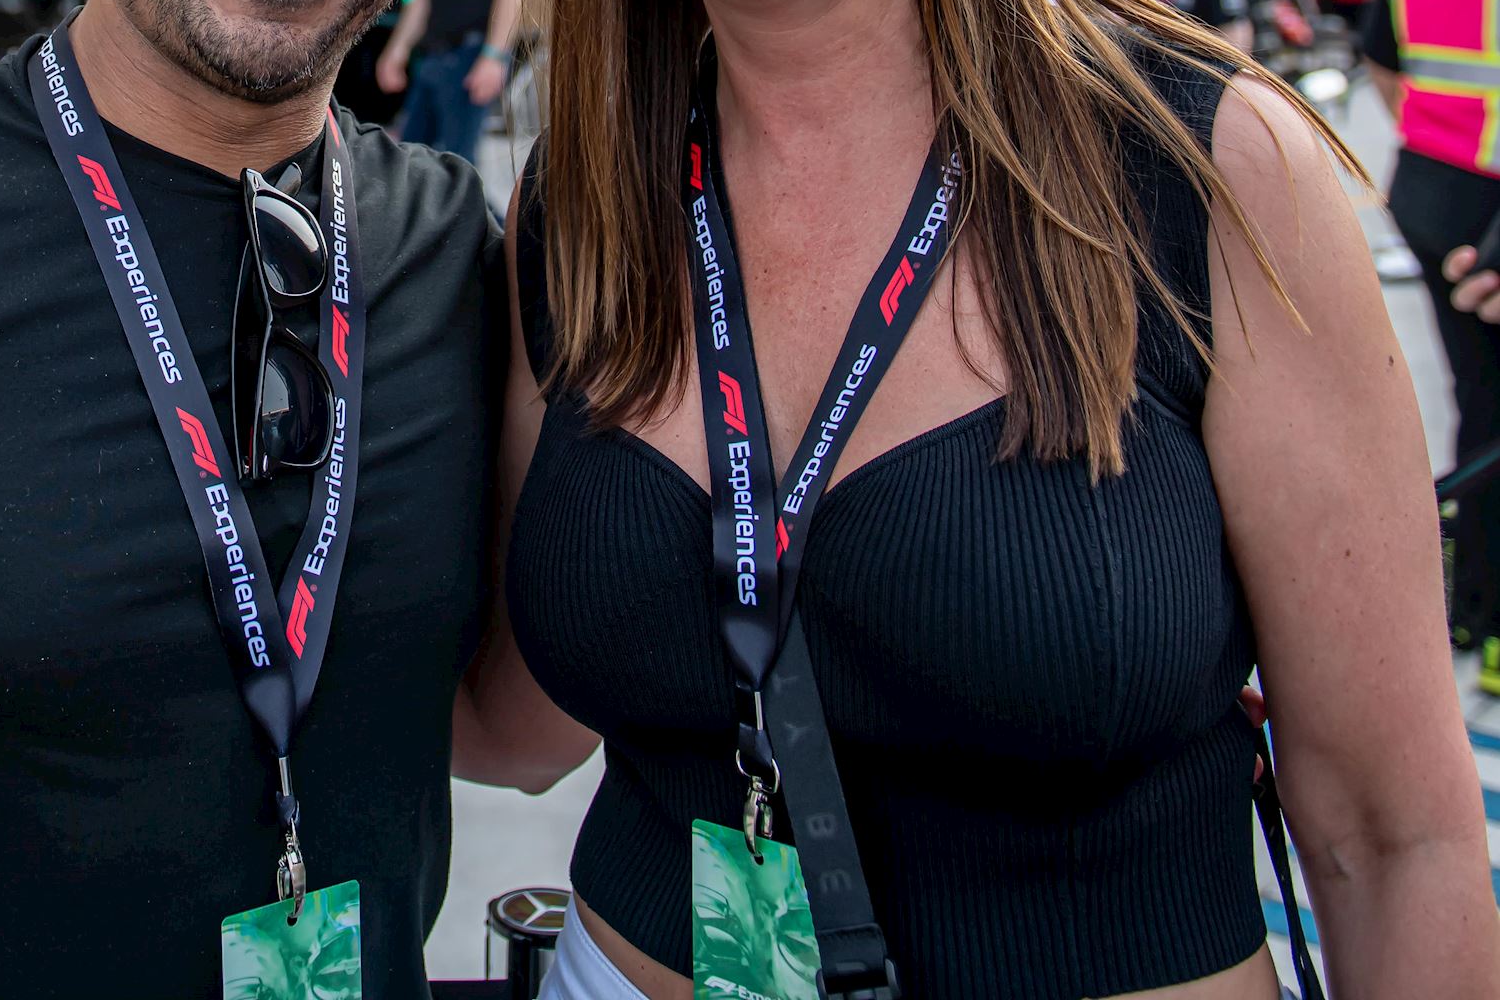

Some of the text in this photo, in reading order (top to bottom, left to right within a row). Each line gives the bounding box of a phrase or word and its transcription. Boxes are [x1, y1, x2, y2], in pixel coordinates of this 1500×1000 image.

[105, 214, 183, 384] Experiences
[330, 158, 350, 305] Experiences
[691, 196, 730, 350] Experiences
[783, 343, 876, 515] Experiences
[205, 483, 270, 667] Experiences
[728, 440, 758, 606] Experiences
